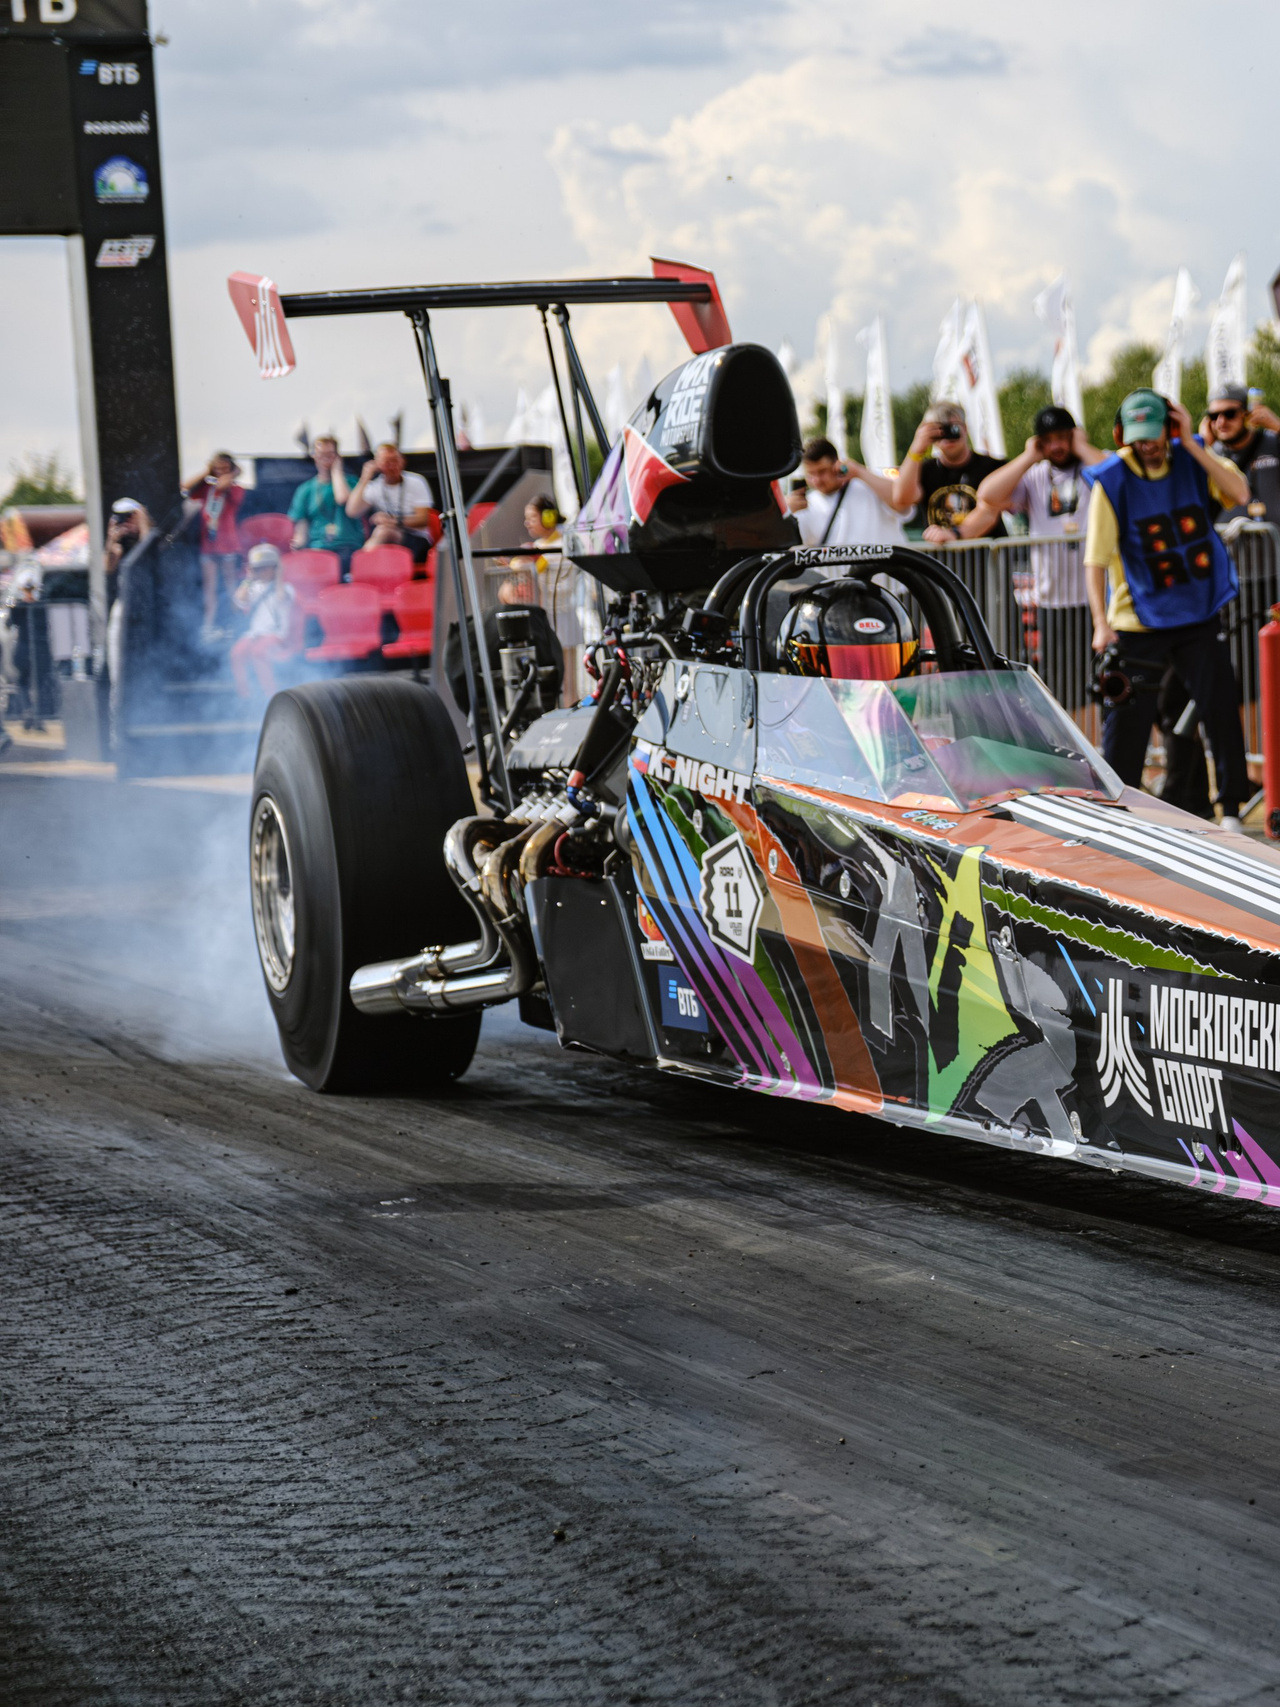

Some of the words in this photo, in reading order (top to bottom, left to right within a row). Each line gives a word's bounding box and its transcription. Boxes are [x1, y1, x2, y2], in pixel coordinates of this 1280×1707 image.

[98, 62, 140, 85] ВТБ
[673, 351, 726, 393] MAX
[663, 385, 707, 429] RIDE
[858, 621, 881, 629] BELL
[724, 882, 743, 918] 11
[677, 987, 699, 1018] ВТБ
[1154, 1058, 1229, 1133] СПОРТ
